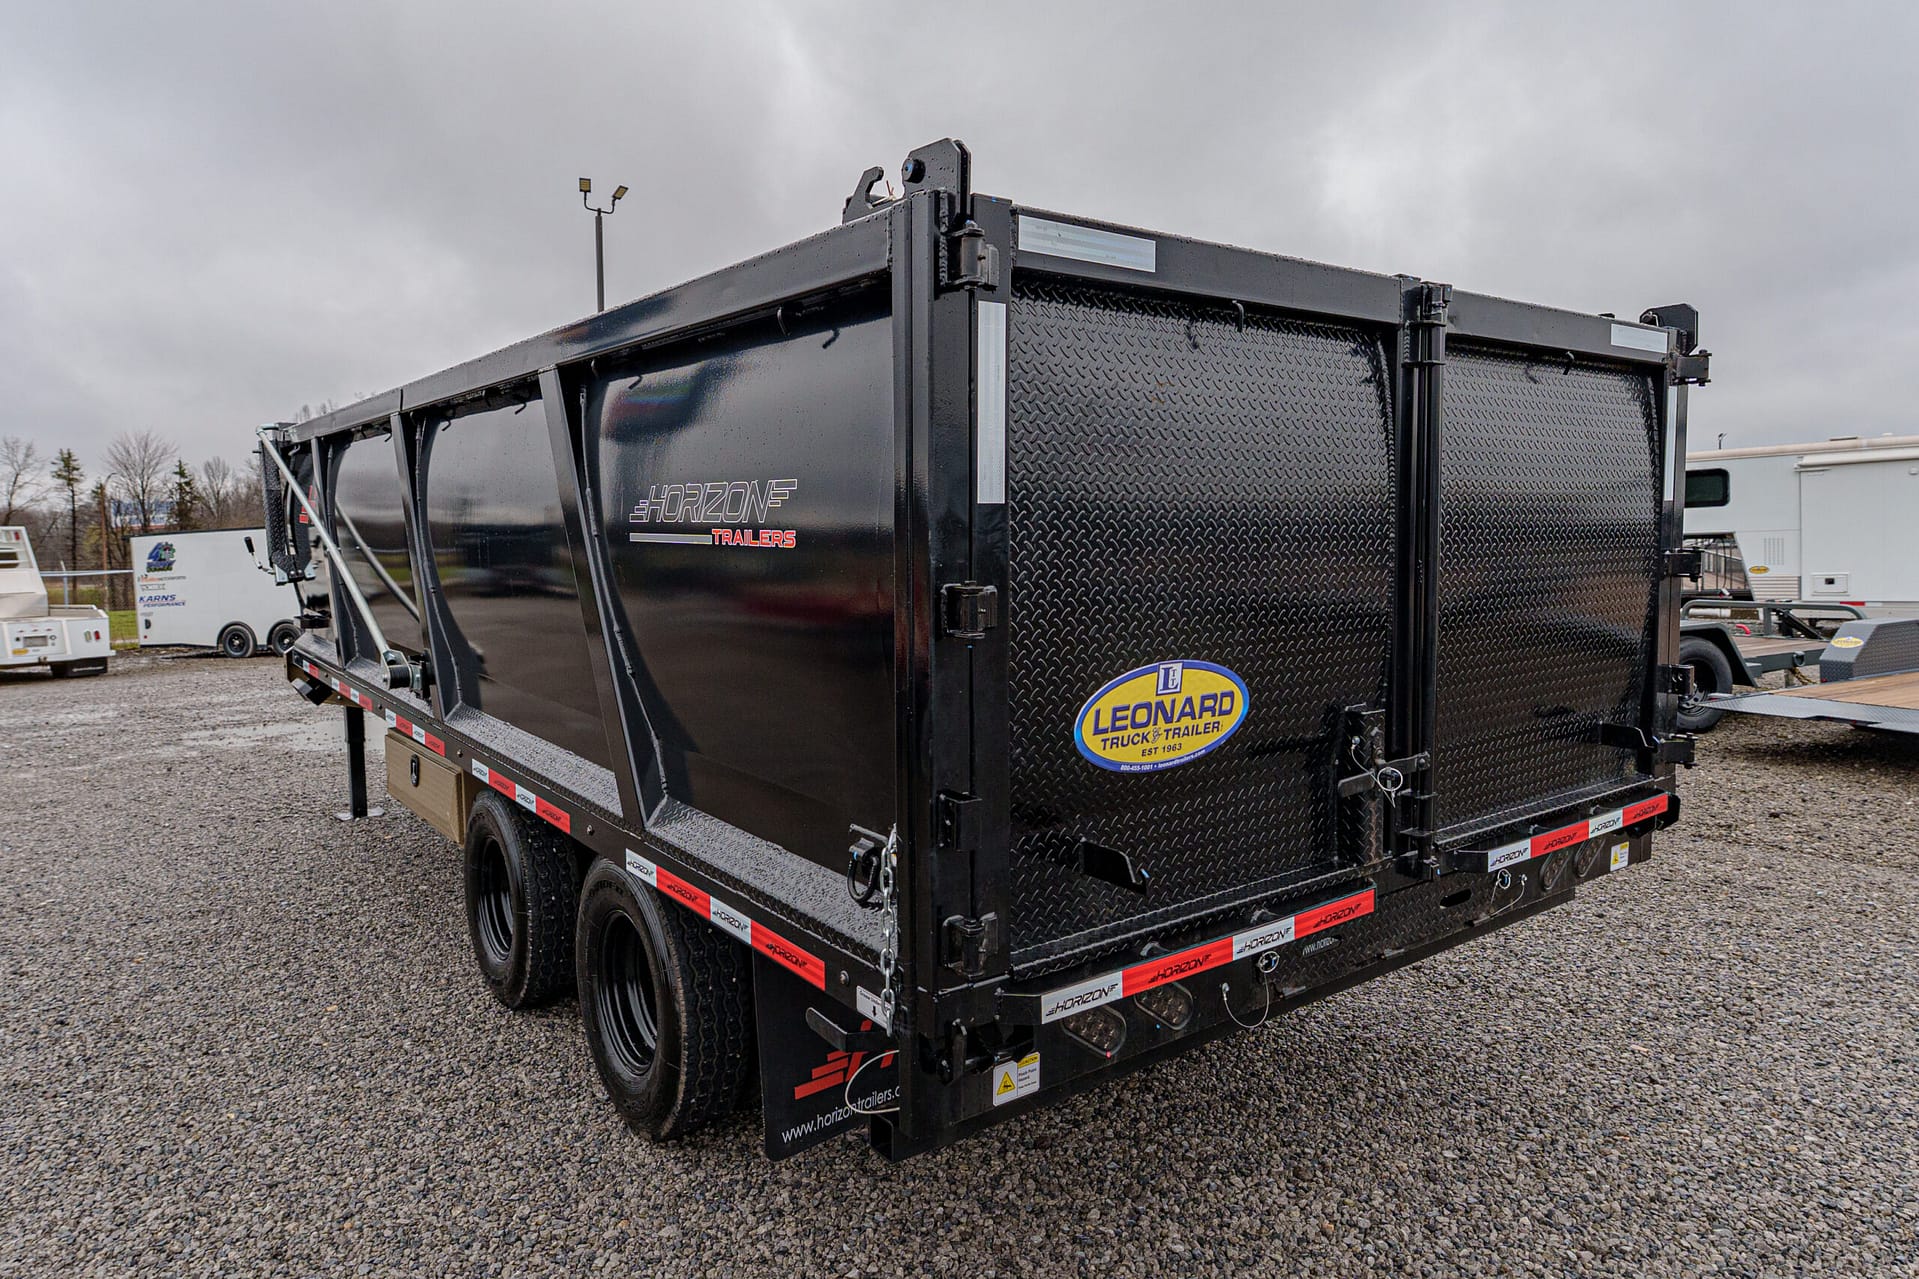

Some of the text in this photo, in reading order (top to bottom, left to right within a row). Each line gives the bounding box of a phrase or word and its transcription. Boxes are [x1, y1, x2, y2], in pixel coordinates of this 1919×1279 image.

[629, 479, 797, 523] HORIZON
[712, 529, 796, 548] TRAILERS
[139, 594, 176, 603] KARNS
[1092, 690, 1235, 736] LEONARD
[1101, 730, 1150, 750] TRUCK
[1163, 721, 1220, 740] TRAILER
[1142, 743, 1182, 757] EST 1963
[1490, 847, 1528, 867] HORIZON
[1313, 903, 1361, 928] HORIZON
[1237, 927, 1292, 954] HORIZON
[1148, 953, 1212, 983] HORIZON
[1046, 984, 1118, 1016] HORIZON
